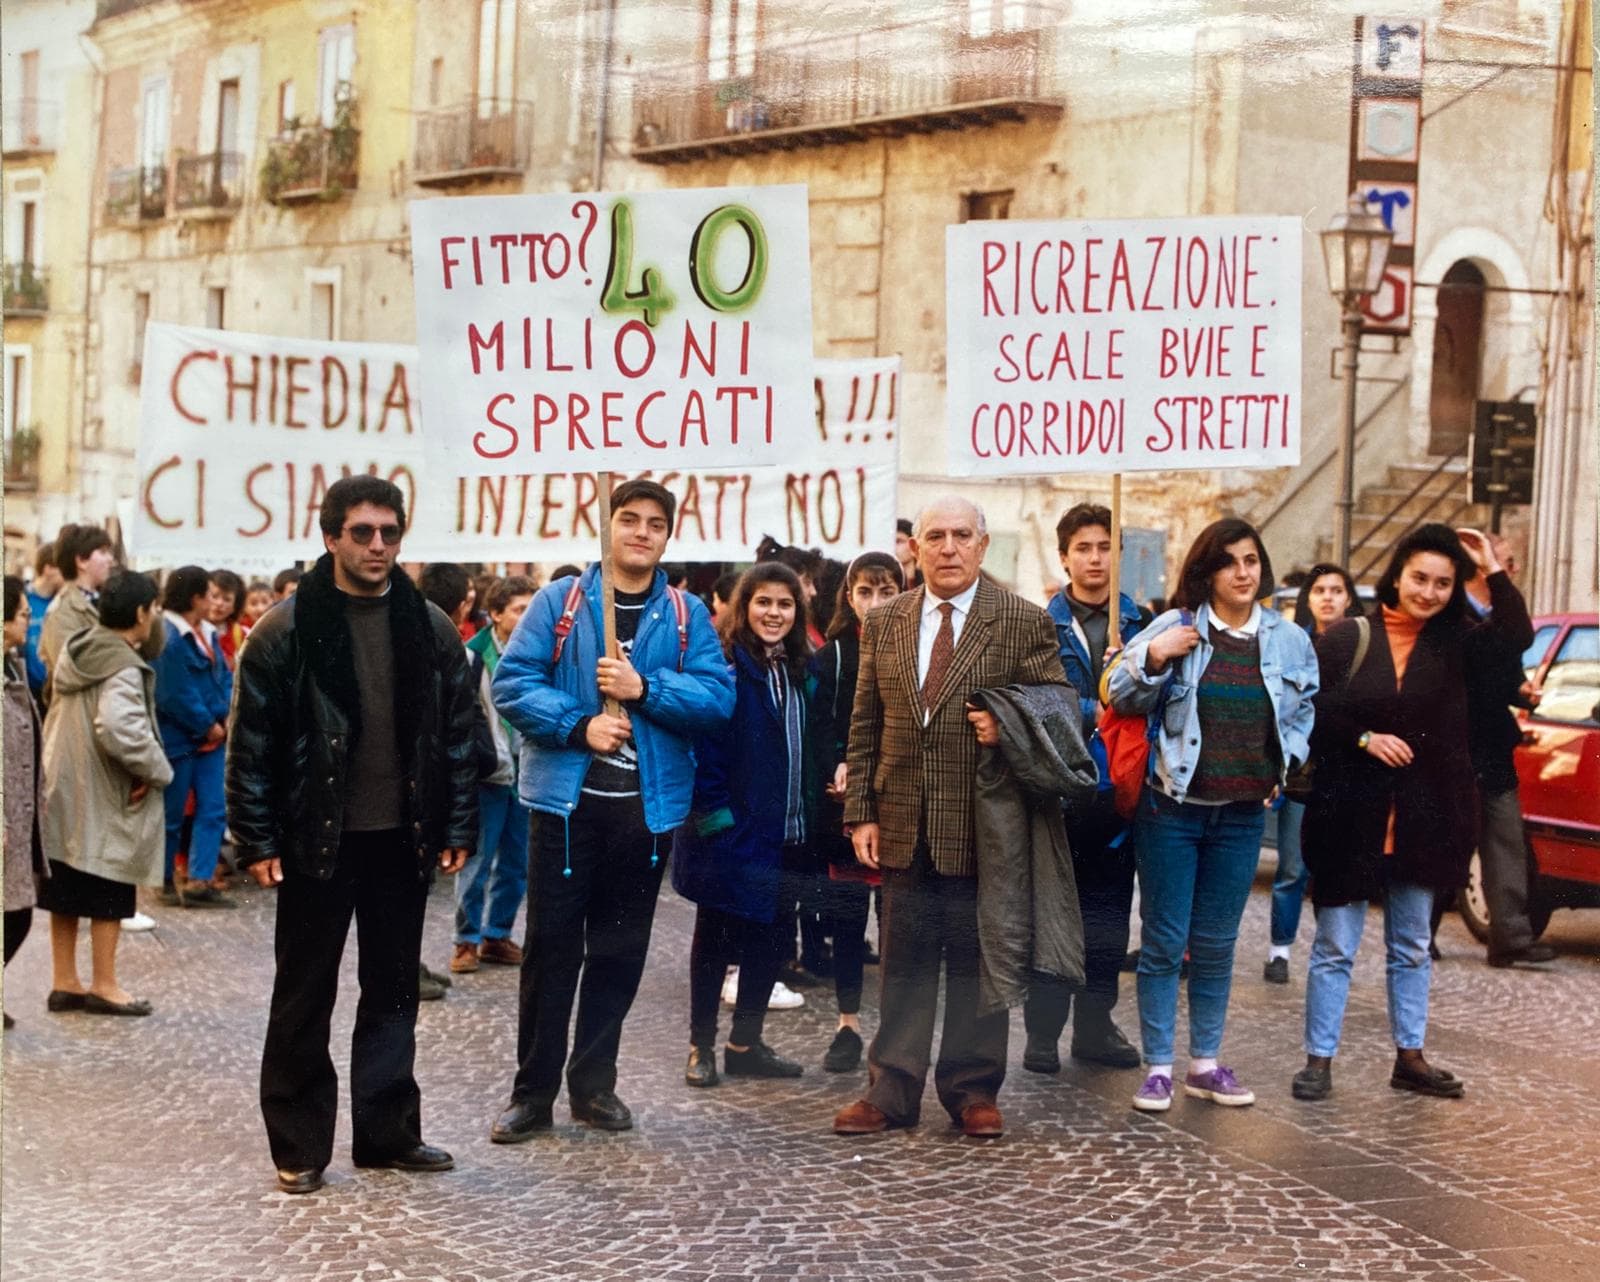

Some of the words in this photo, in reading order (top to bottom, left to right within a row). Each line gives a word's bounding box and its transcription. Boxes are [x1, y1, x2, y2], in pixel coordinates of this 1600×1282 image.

[440, 200, 598, 290] FITTO?
[600, 202, 769, 328] 40
[982, 236, 1278, 317] RICREAZIONE:
[467, 317, 750, 379] MILIONI
[993, 329, 1124, 383] SCALE
[1250, 325, 1268, 378] E
[472, 385, 773, 459] SPRECATI
[971, 398, 1124, 458] CORRIDOI
[1145, 393, 1290, 452] STRETTI
[143, 455, 205, 529] CI
[237, 462, 416, 541] SIAO
[456, 470, 752, 546] INTERATI
[785, 466, 865, 547] NOI
